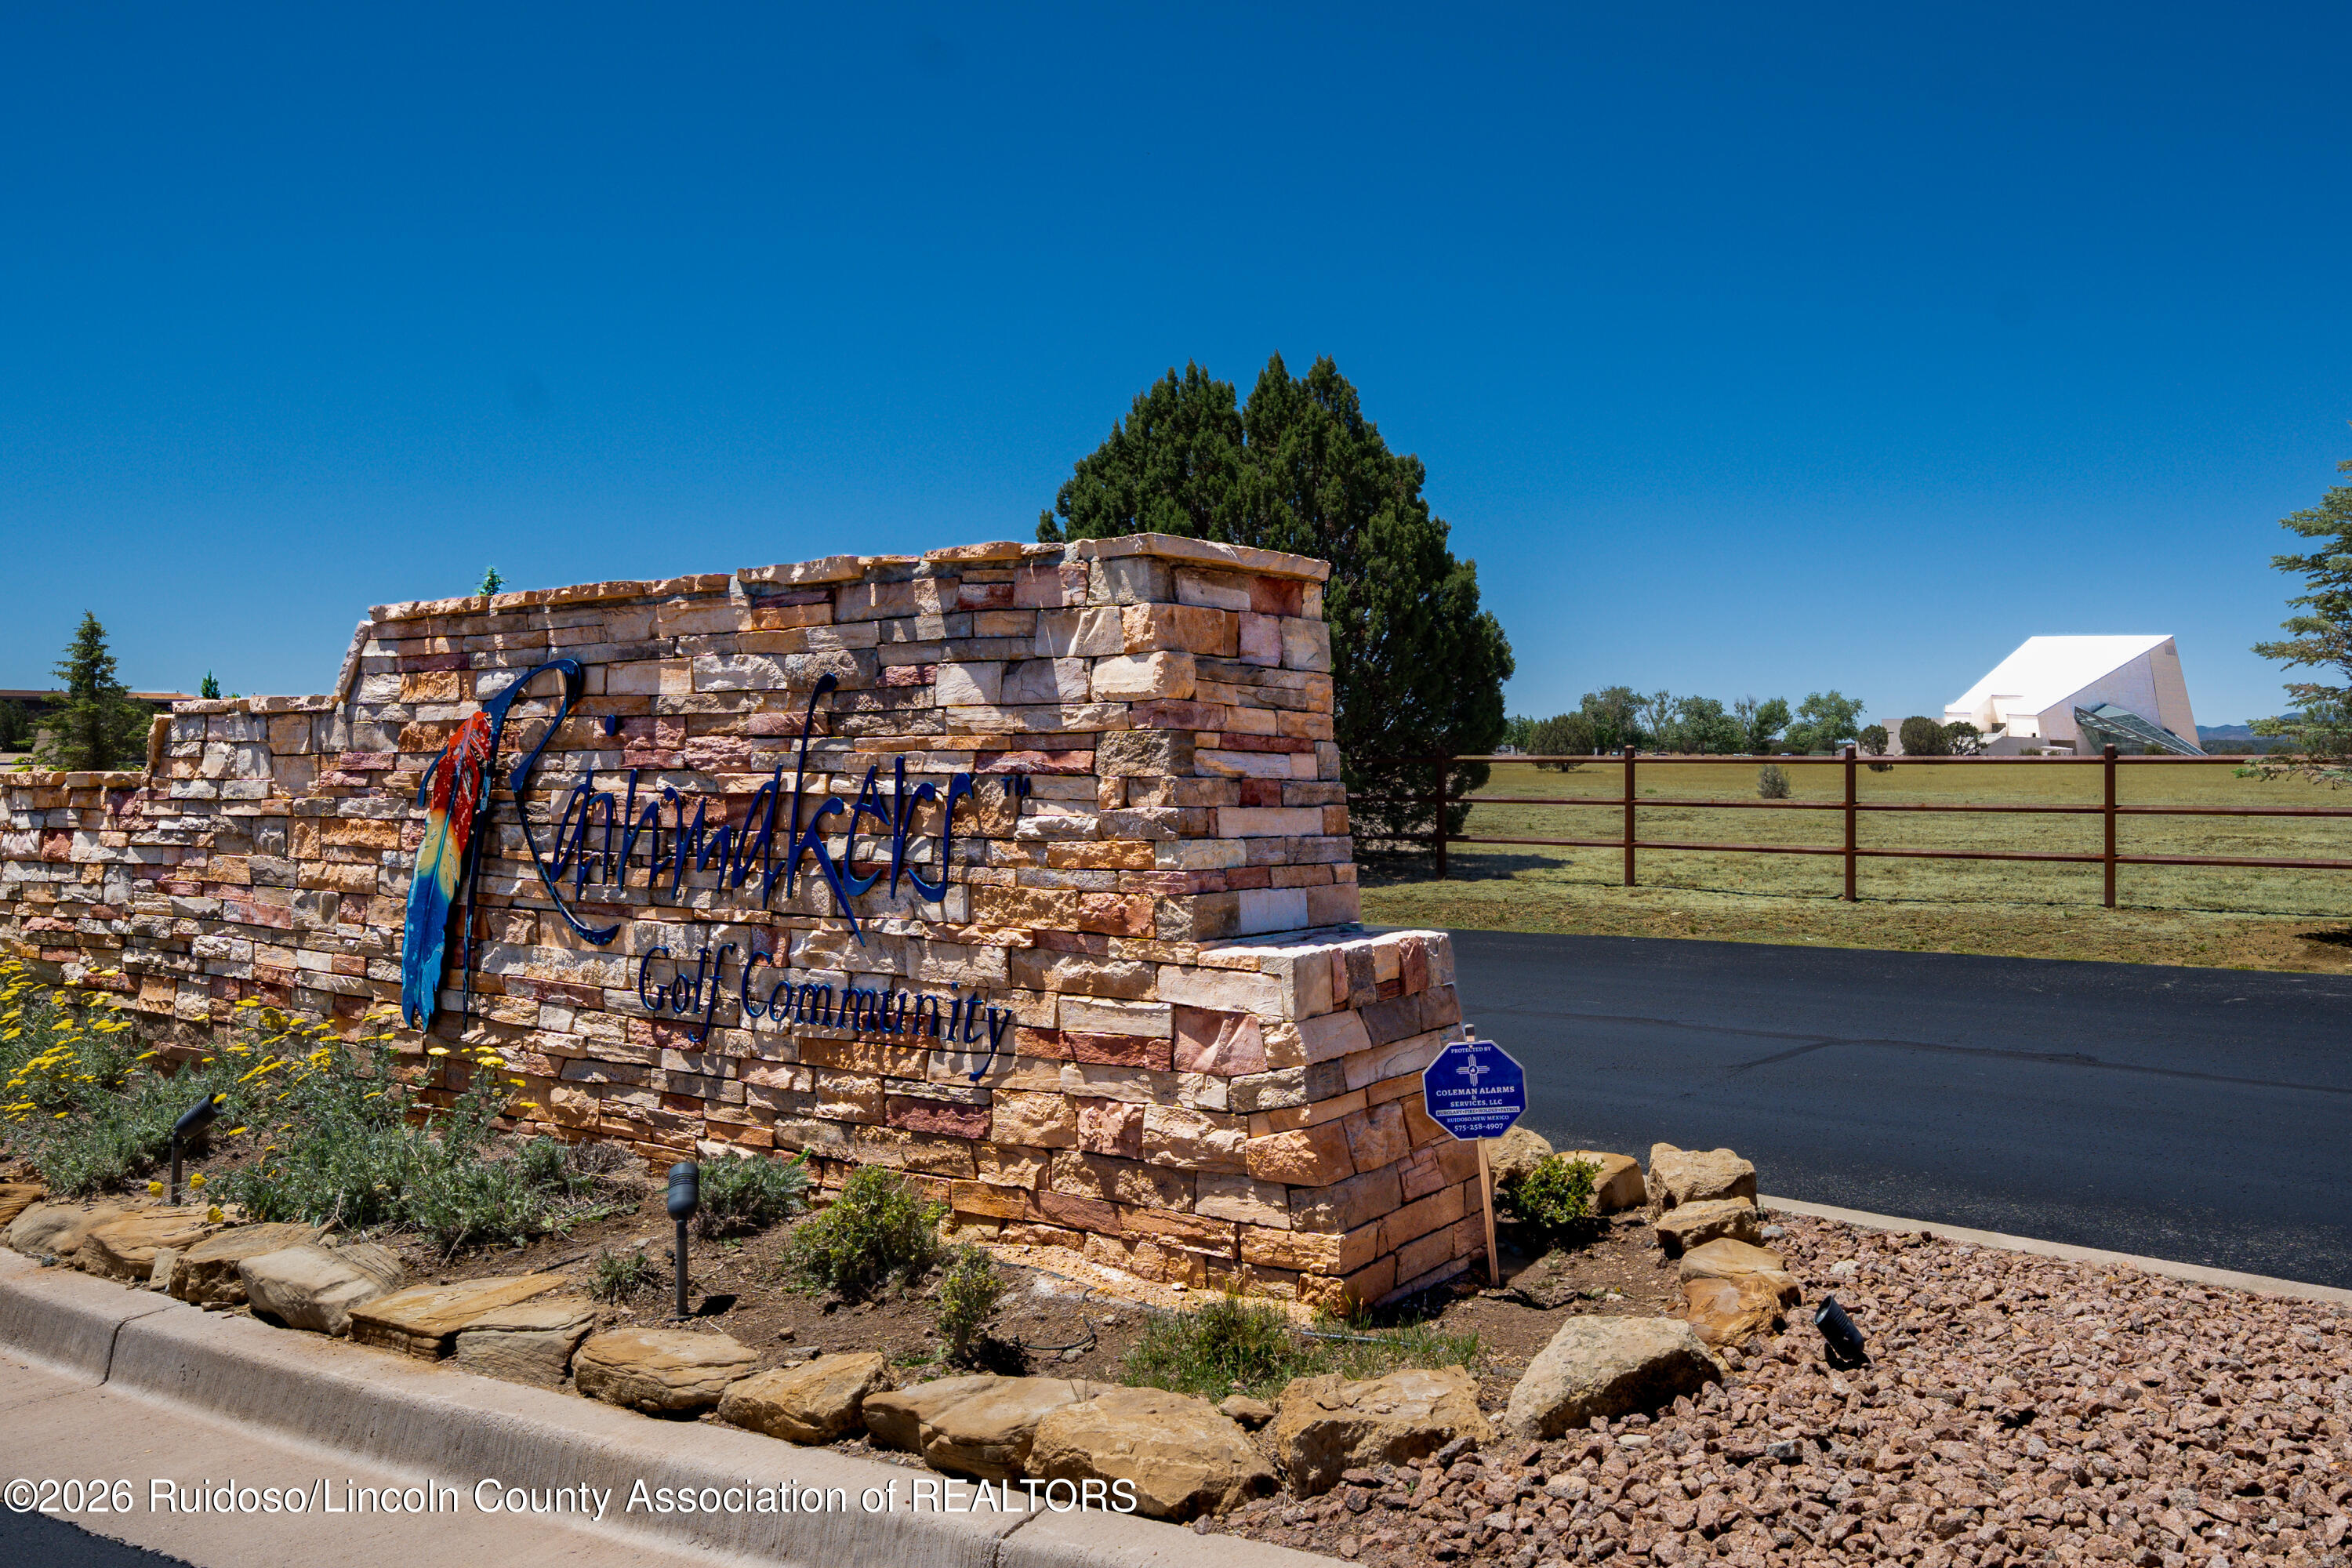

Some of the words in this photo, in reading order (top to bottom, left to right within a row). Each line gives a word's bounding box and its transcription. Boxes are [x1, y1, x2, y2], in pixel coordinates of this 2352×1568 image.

[638, 942, 737, 1044] Golf
[741, 950, 1012, 1082] Community
[1436, 1087, 1478, 1097] COLEMAN
[1479, 1086, 1515, 1094] ALARMS
[1454, 1123, 1504, 1132] 575-258-4907
